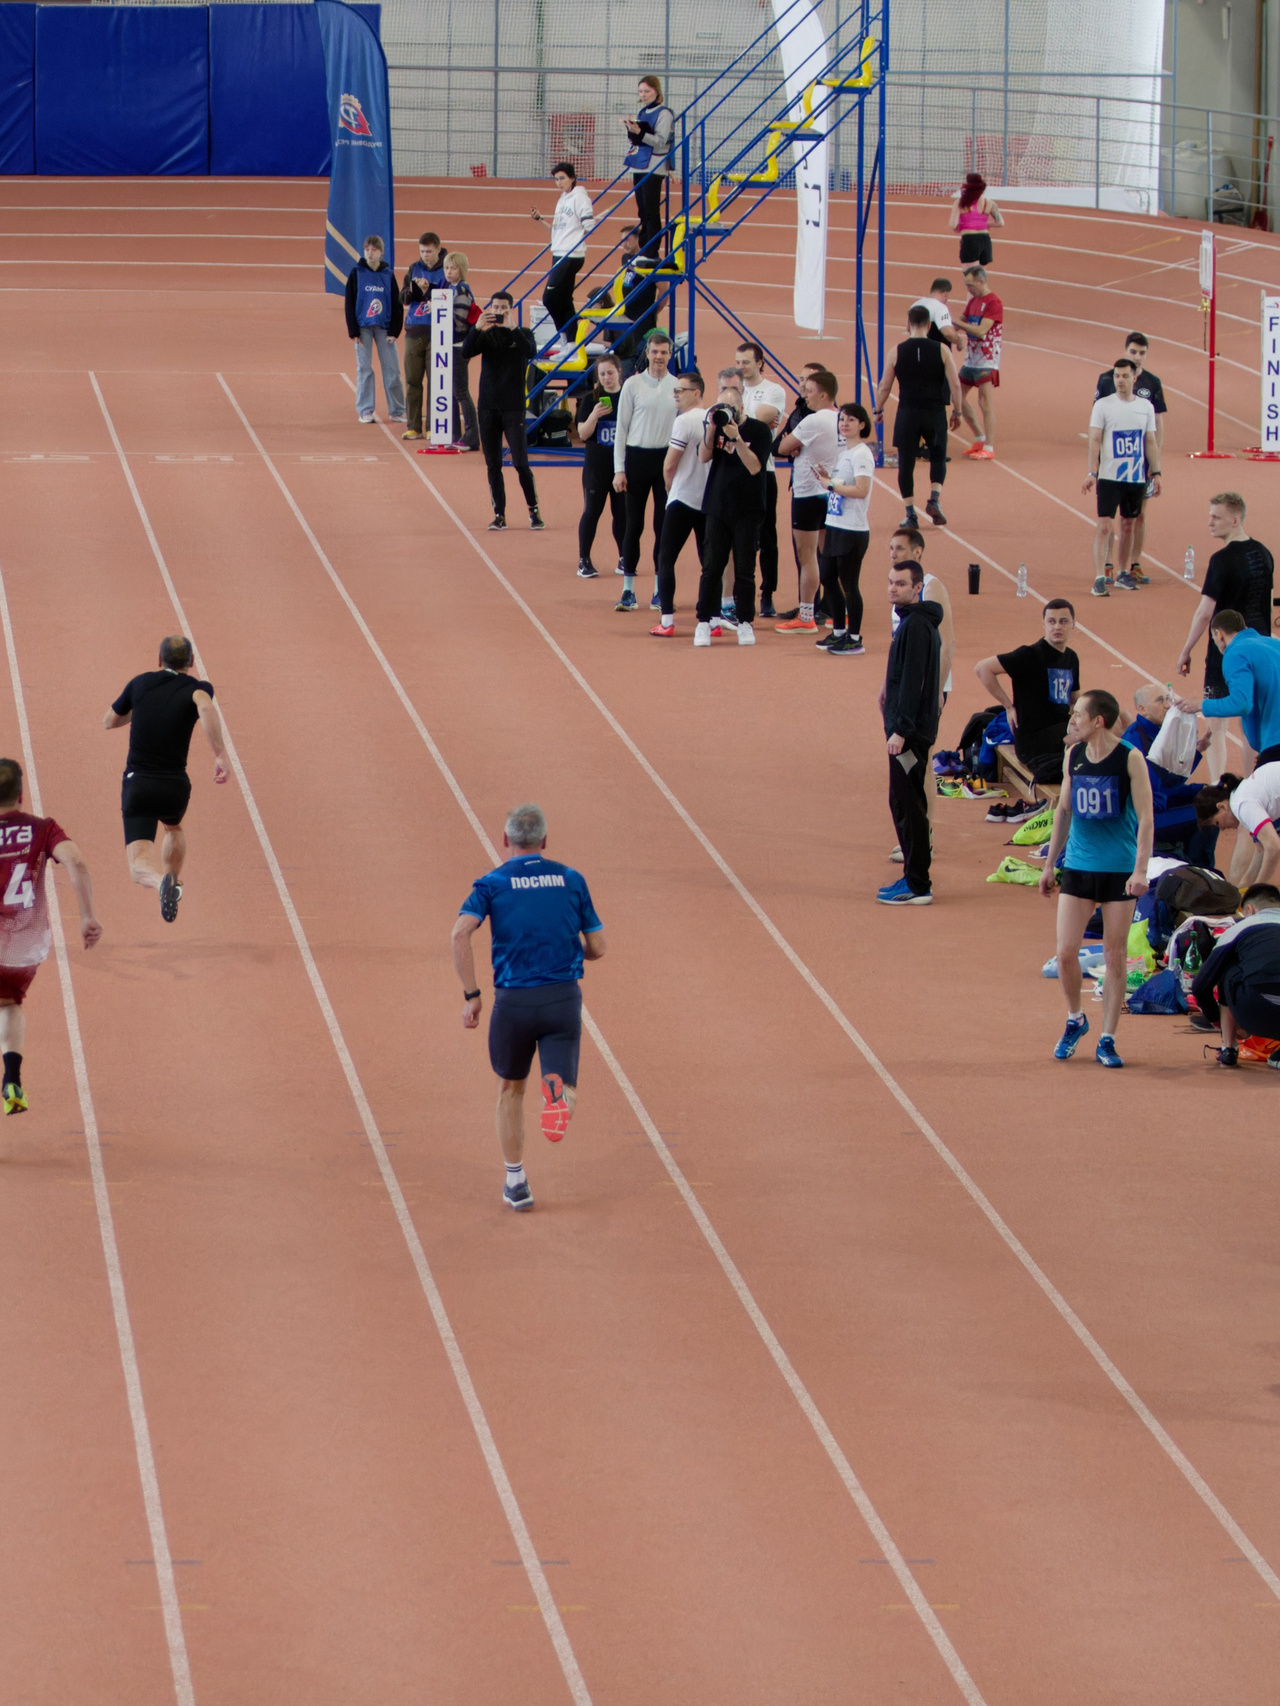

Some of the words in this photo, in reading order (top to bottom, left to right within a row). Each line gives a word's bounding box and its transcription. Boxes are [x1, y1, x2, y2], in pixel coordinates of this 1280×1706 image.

[435, 308, 449, 434] FINISH
[1266, 316, 1280, 441] FINISH
[1115, 436, 1140, 455] 054
[1076, 787, 1113, 814] 091
